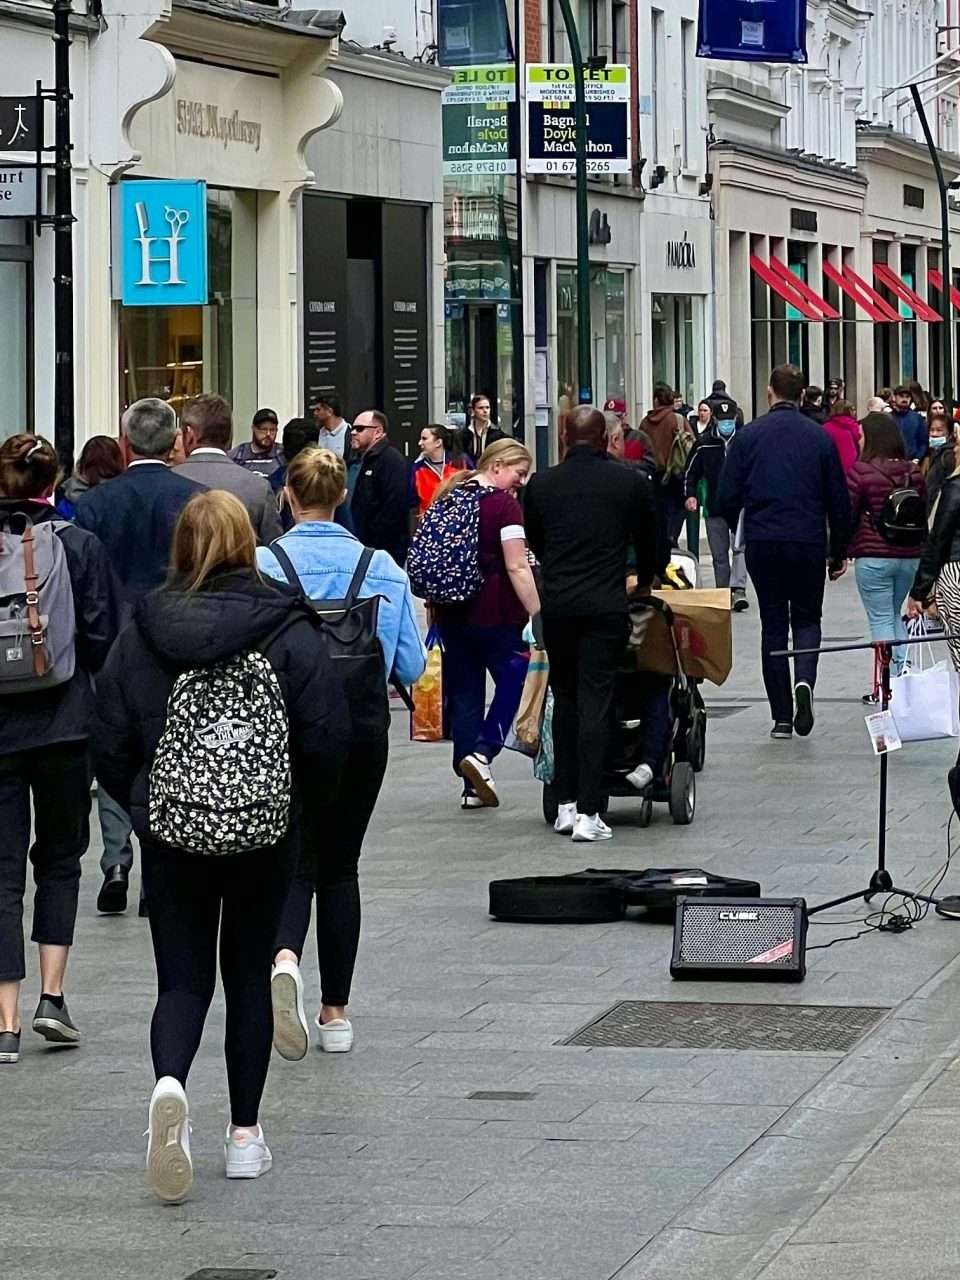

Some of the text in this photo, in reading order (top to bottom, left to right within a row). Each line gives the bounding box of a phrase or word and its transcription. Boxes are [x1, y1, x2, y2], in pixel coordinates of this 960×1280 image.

[543, 69, 570, 81] TO
[543, 114, 590, 128] Bagnl
[543, 140, 613, 153] MacMhon
[546, 162, 558, 171] 01
[0, 170, 24, 183] urt
[0, 190, 12, 200] se
